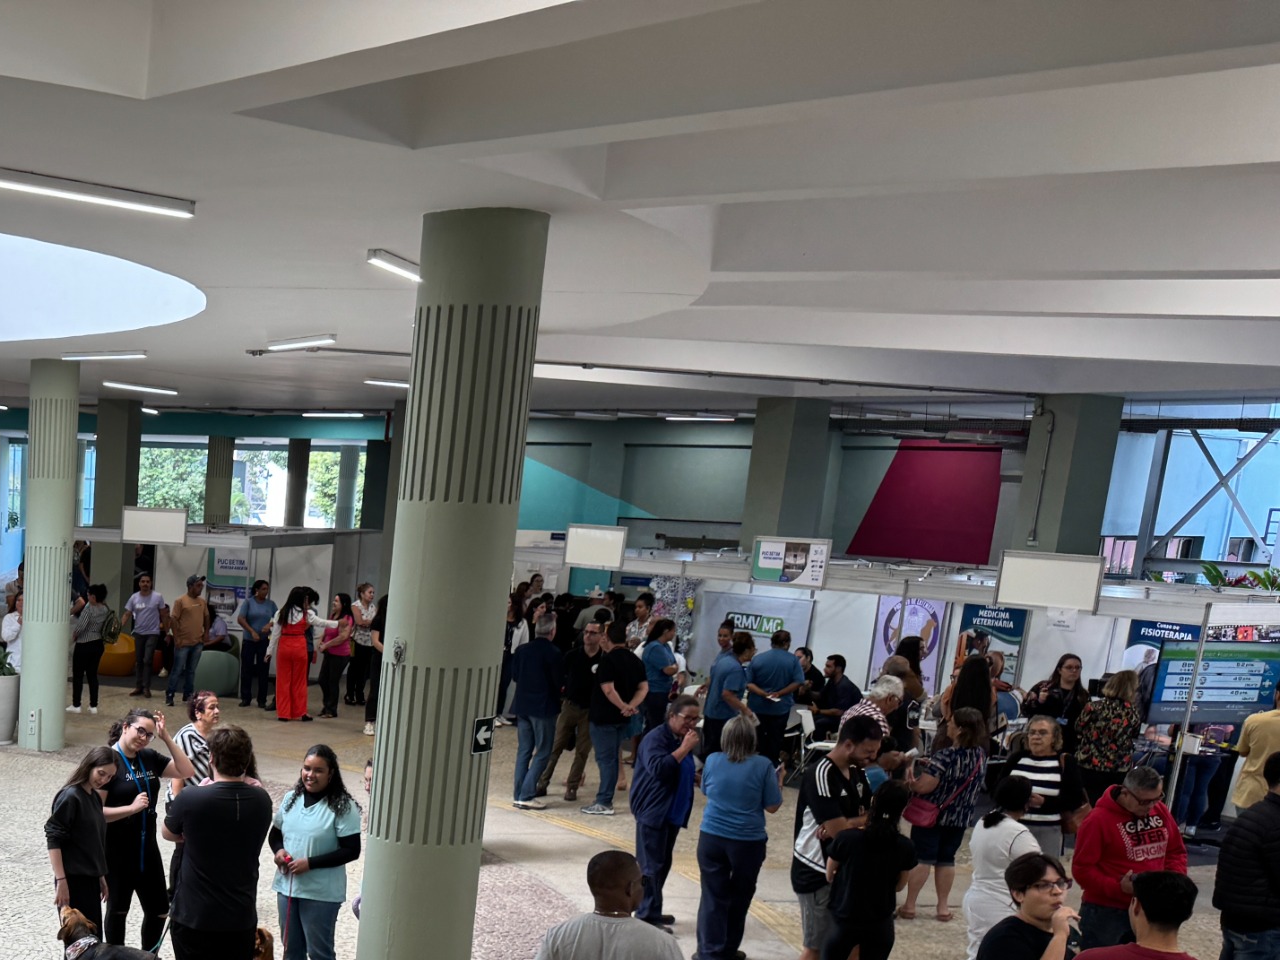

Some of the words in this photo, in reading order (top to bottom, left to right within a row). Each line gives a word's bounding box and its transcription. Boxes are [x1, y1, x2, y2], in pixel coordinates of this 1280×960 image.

[978, 609, 1010, 619] MEDICINA
[761, 618, 782, 632] MG
[972, 617, 1014, 629] VETERINÁRIA
[1140, 627, 1192, 640] FISIOTERAPIA
